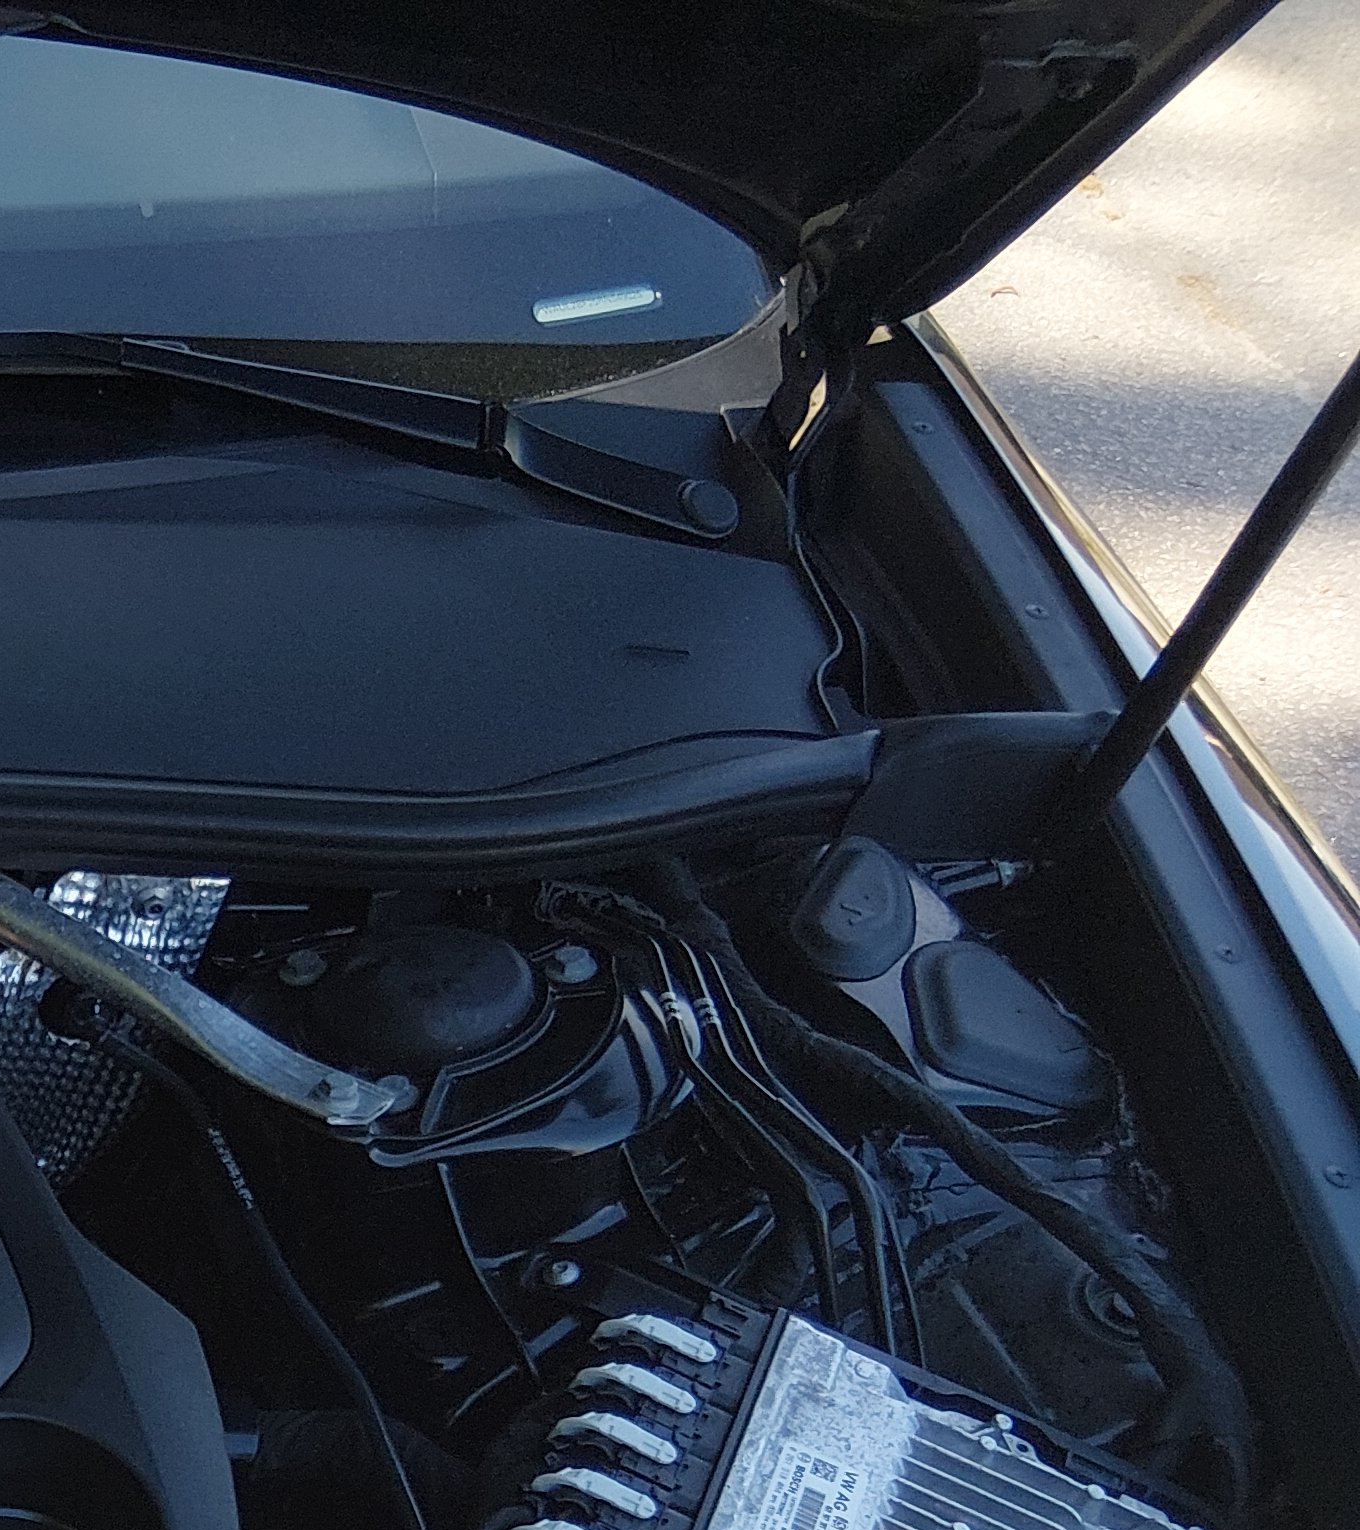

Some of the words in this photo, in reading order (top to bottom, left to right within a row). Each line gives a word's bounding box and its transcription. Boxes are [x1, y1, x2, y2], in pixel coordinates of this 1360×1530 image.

[787, 1464, 806, 1495] BOSCH
[839, 1471, 859, 1494] VW
[833, 1492, 850, 1513] AG
